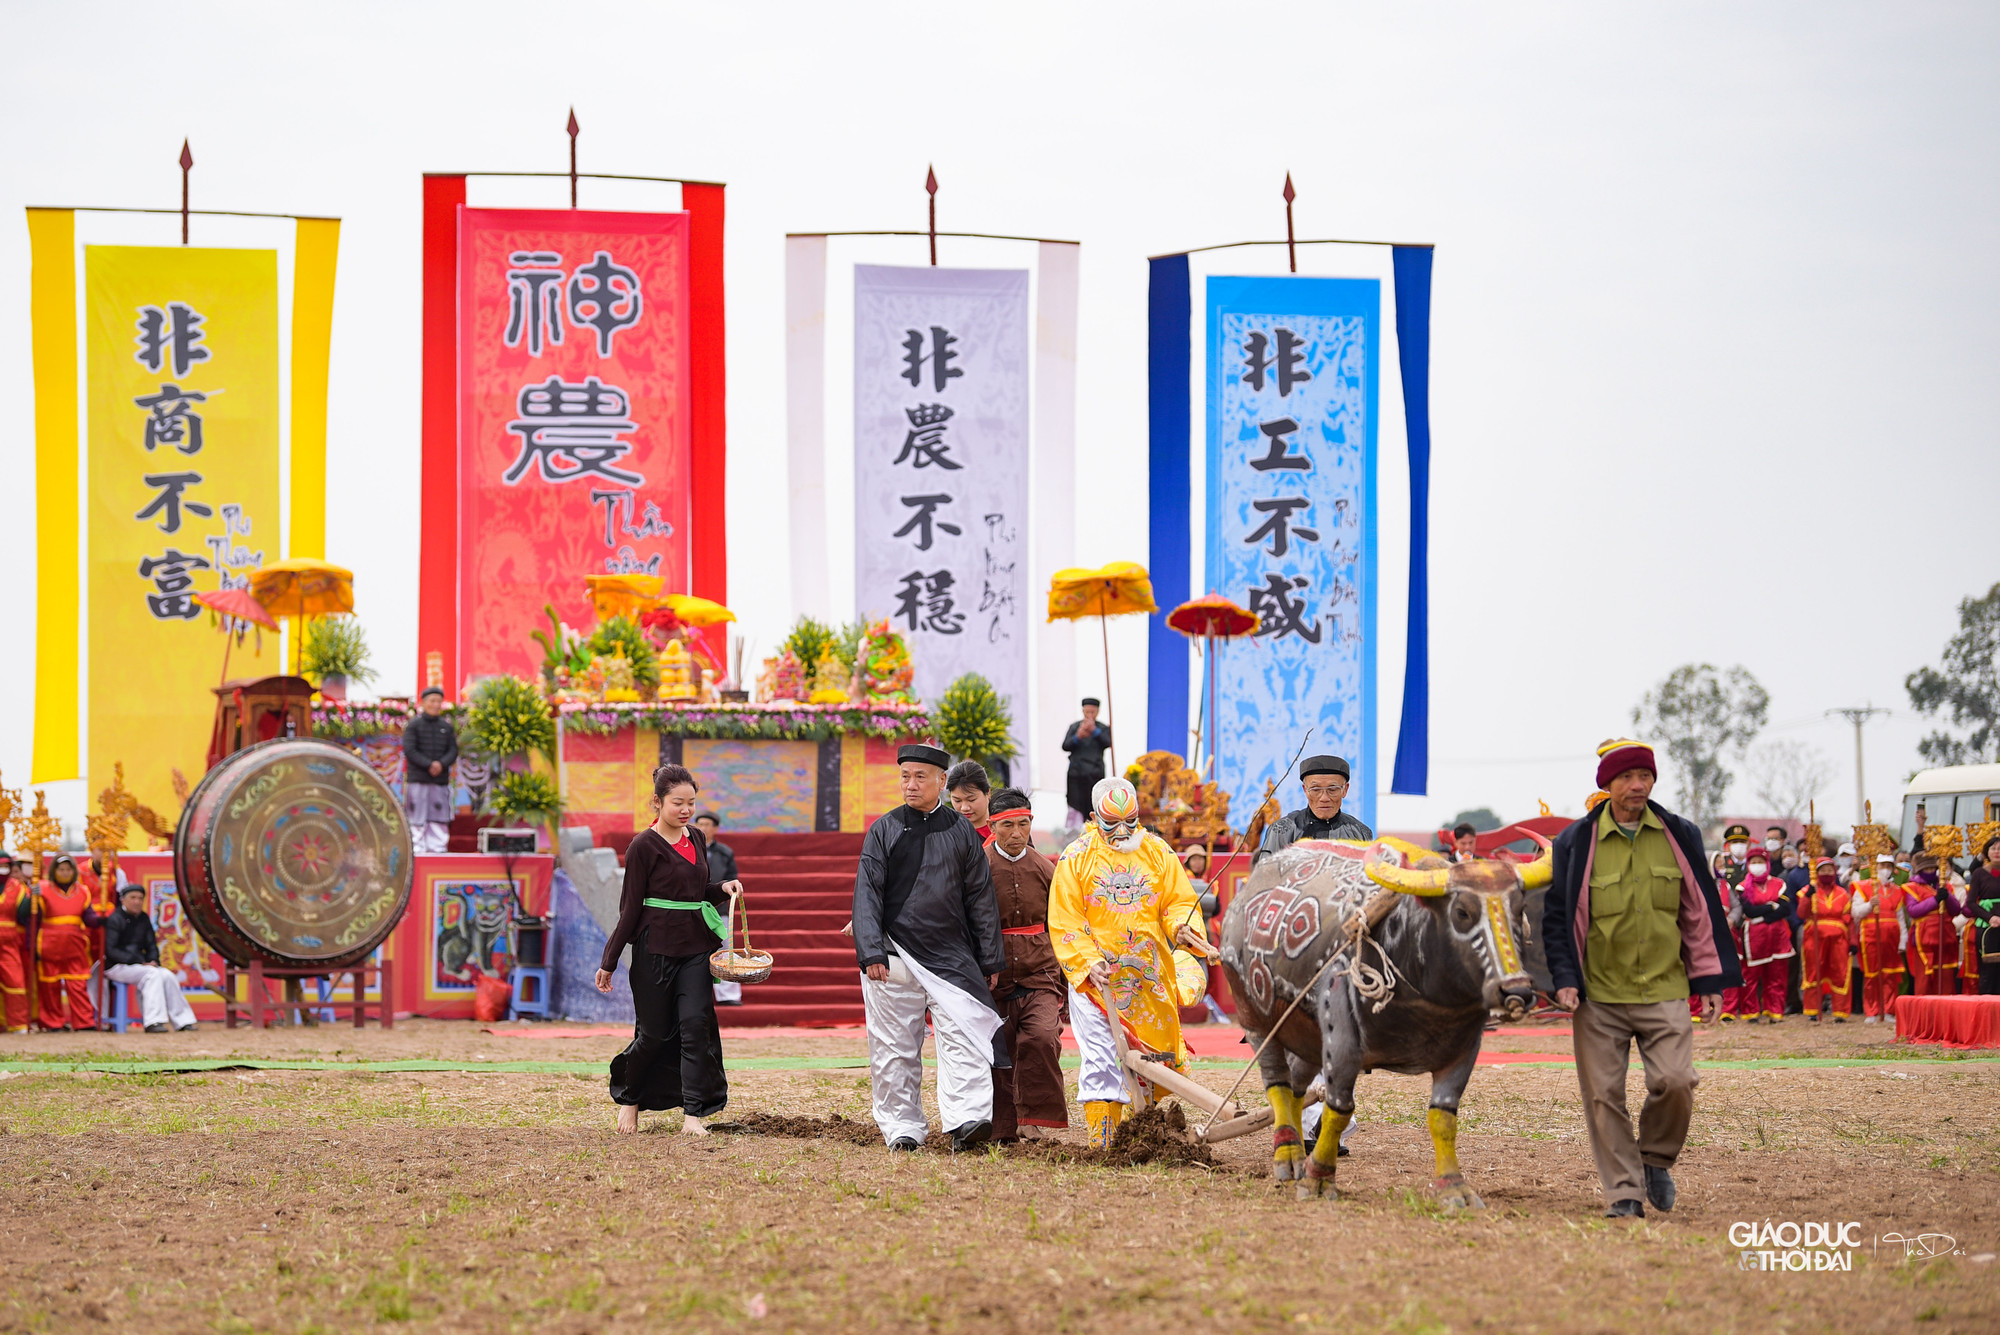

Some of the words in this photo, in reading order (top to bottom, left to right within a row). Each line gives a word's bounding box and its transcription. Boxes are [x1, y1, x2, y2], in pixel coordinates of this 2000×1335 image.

[135, 302, 212, 621] 非商不富
[503, 251, 646, 485] 神農
[1242, 327, 1322, 645] 非工不盛
